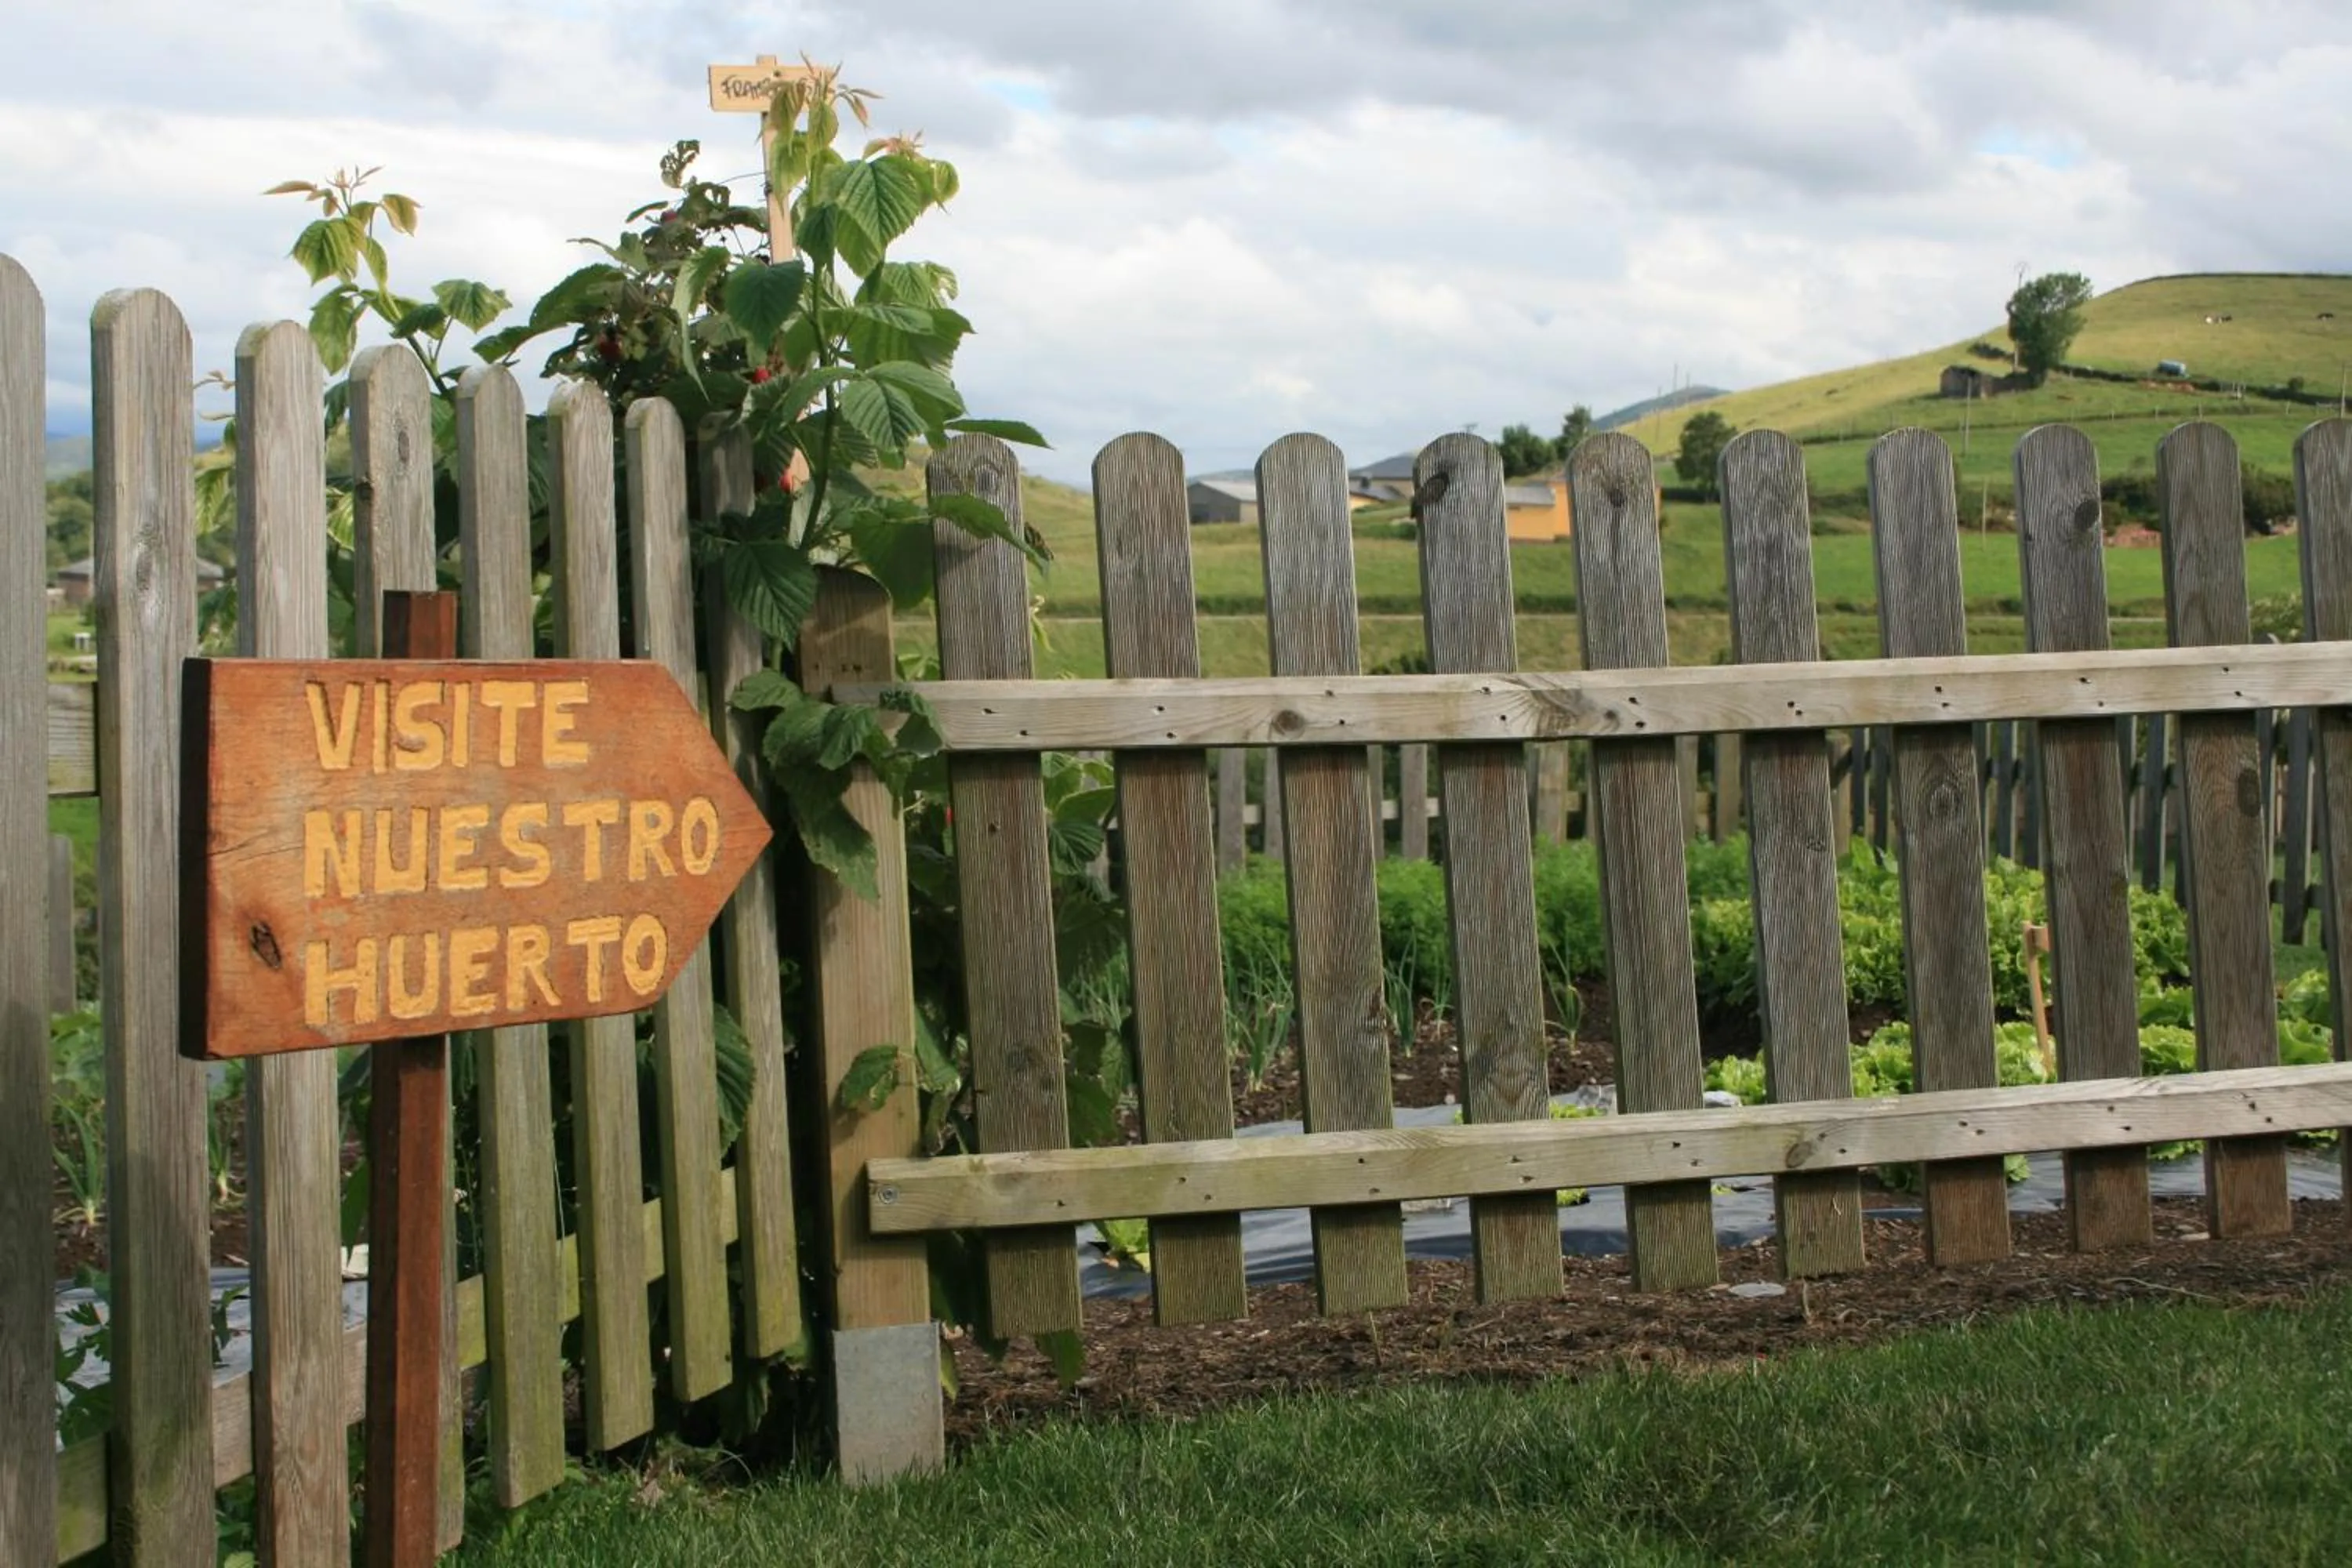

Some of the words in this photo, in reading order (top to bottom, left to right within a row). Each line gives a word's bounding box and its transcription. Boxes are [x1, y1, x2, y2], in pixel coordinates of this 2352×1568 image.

[305, 679, 590, 774] VISITE
[303, 797, 720, 898] NUESTRO
[304, 913, 668, 1025] HUERTO
